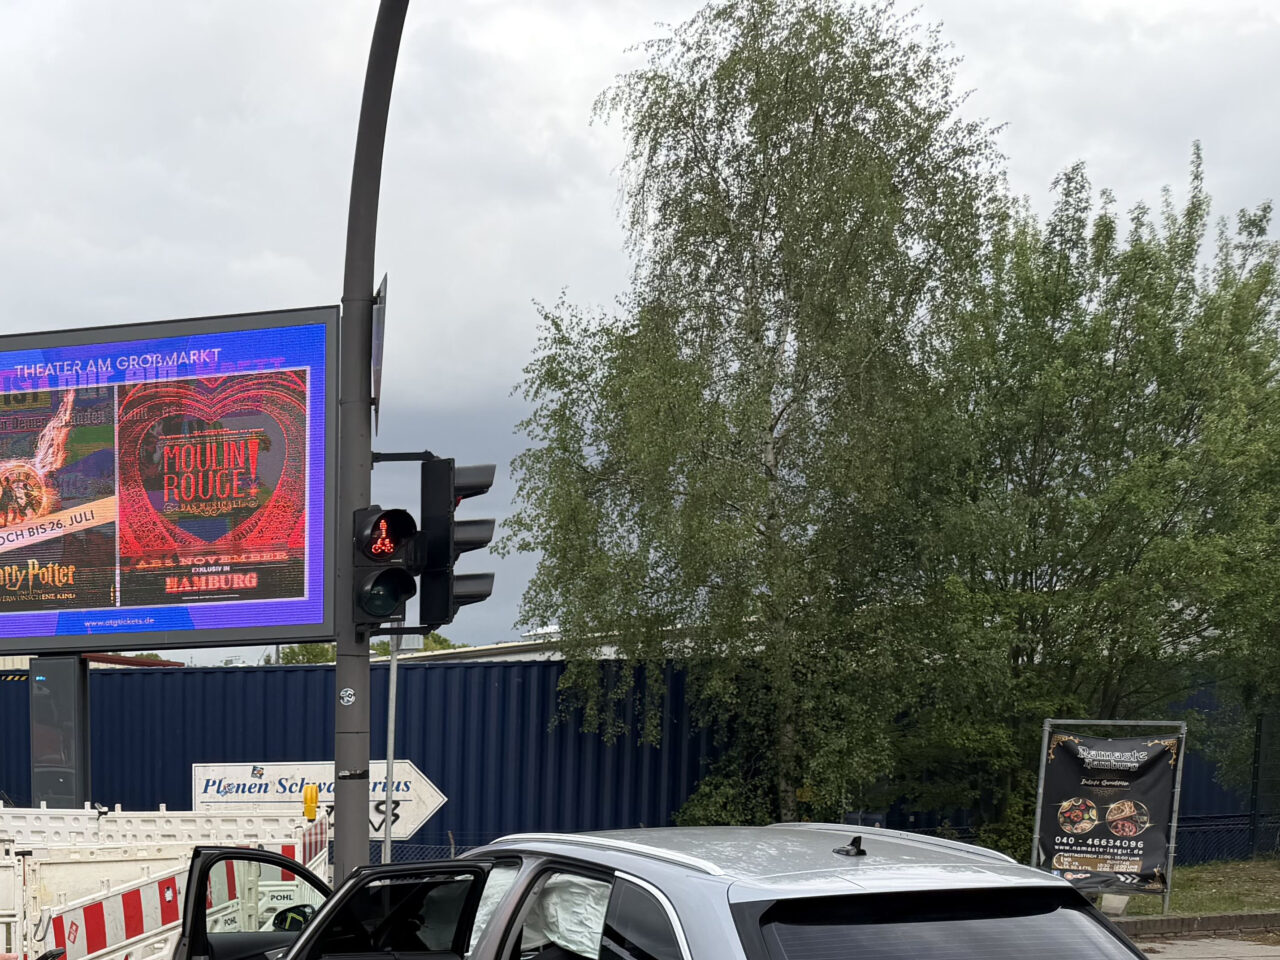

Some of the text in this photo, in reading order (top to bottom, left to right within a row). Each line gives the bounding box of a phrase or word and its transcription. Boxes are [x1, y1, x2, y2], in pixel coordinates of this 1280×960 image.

[14, 361, 81, 378] THEATER
[86, 358, 112, 373] AM
[116, 348, 222, 370] GROßMARKT
[164, 441, 245, 473] MOULIN
[164, 469, 246, 503] ROUGE
[27, 524, 48, 538] BIS
[48, 520, 66, 532] 26.
[69, 510, 95, 527] JULI
[27, 559, 76, 595] Potter
[165, 572, 258, 593] HAMBURG
[83, 617, 155, 627] www.atgtickets.de
[1077, 745, 1148, 762] Namaste
[1055, 836, 1075, 844] 040
[1086, 838, 1144, 848] 46634096
[270, 894, 294, 902] POHL
